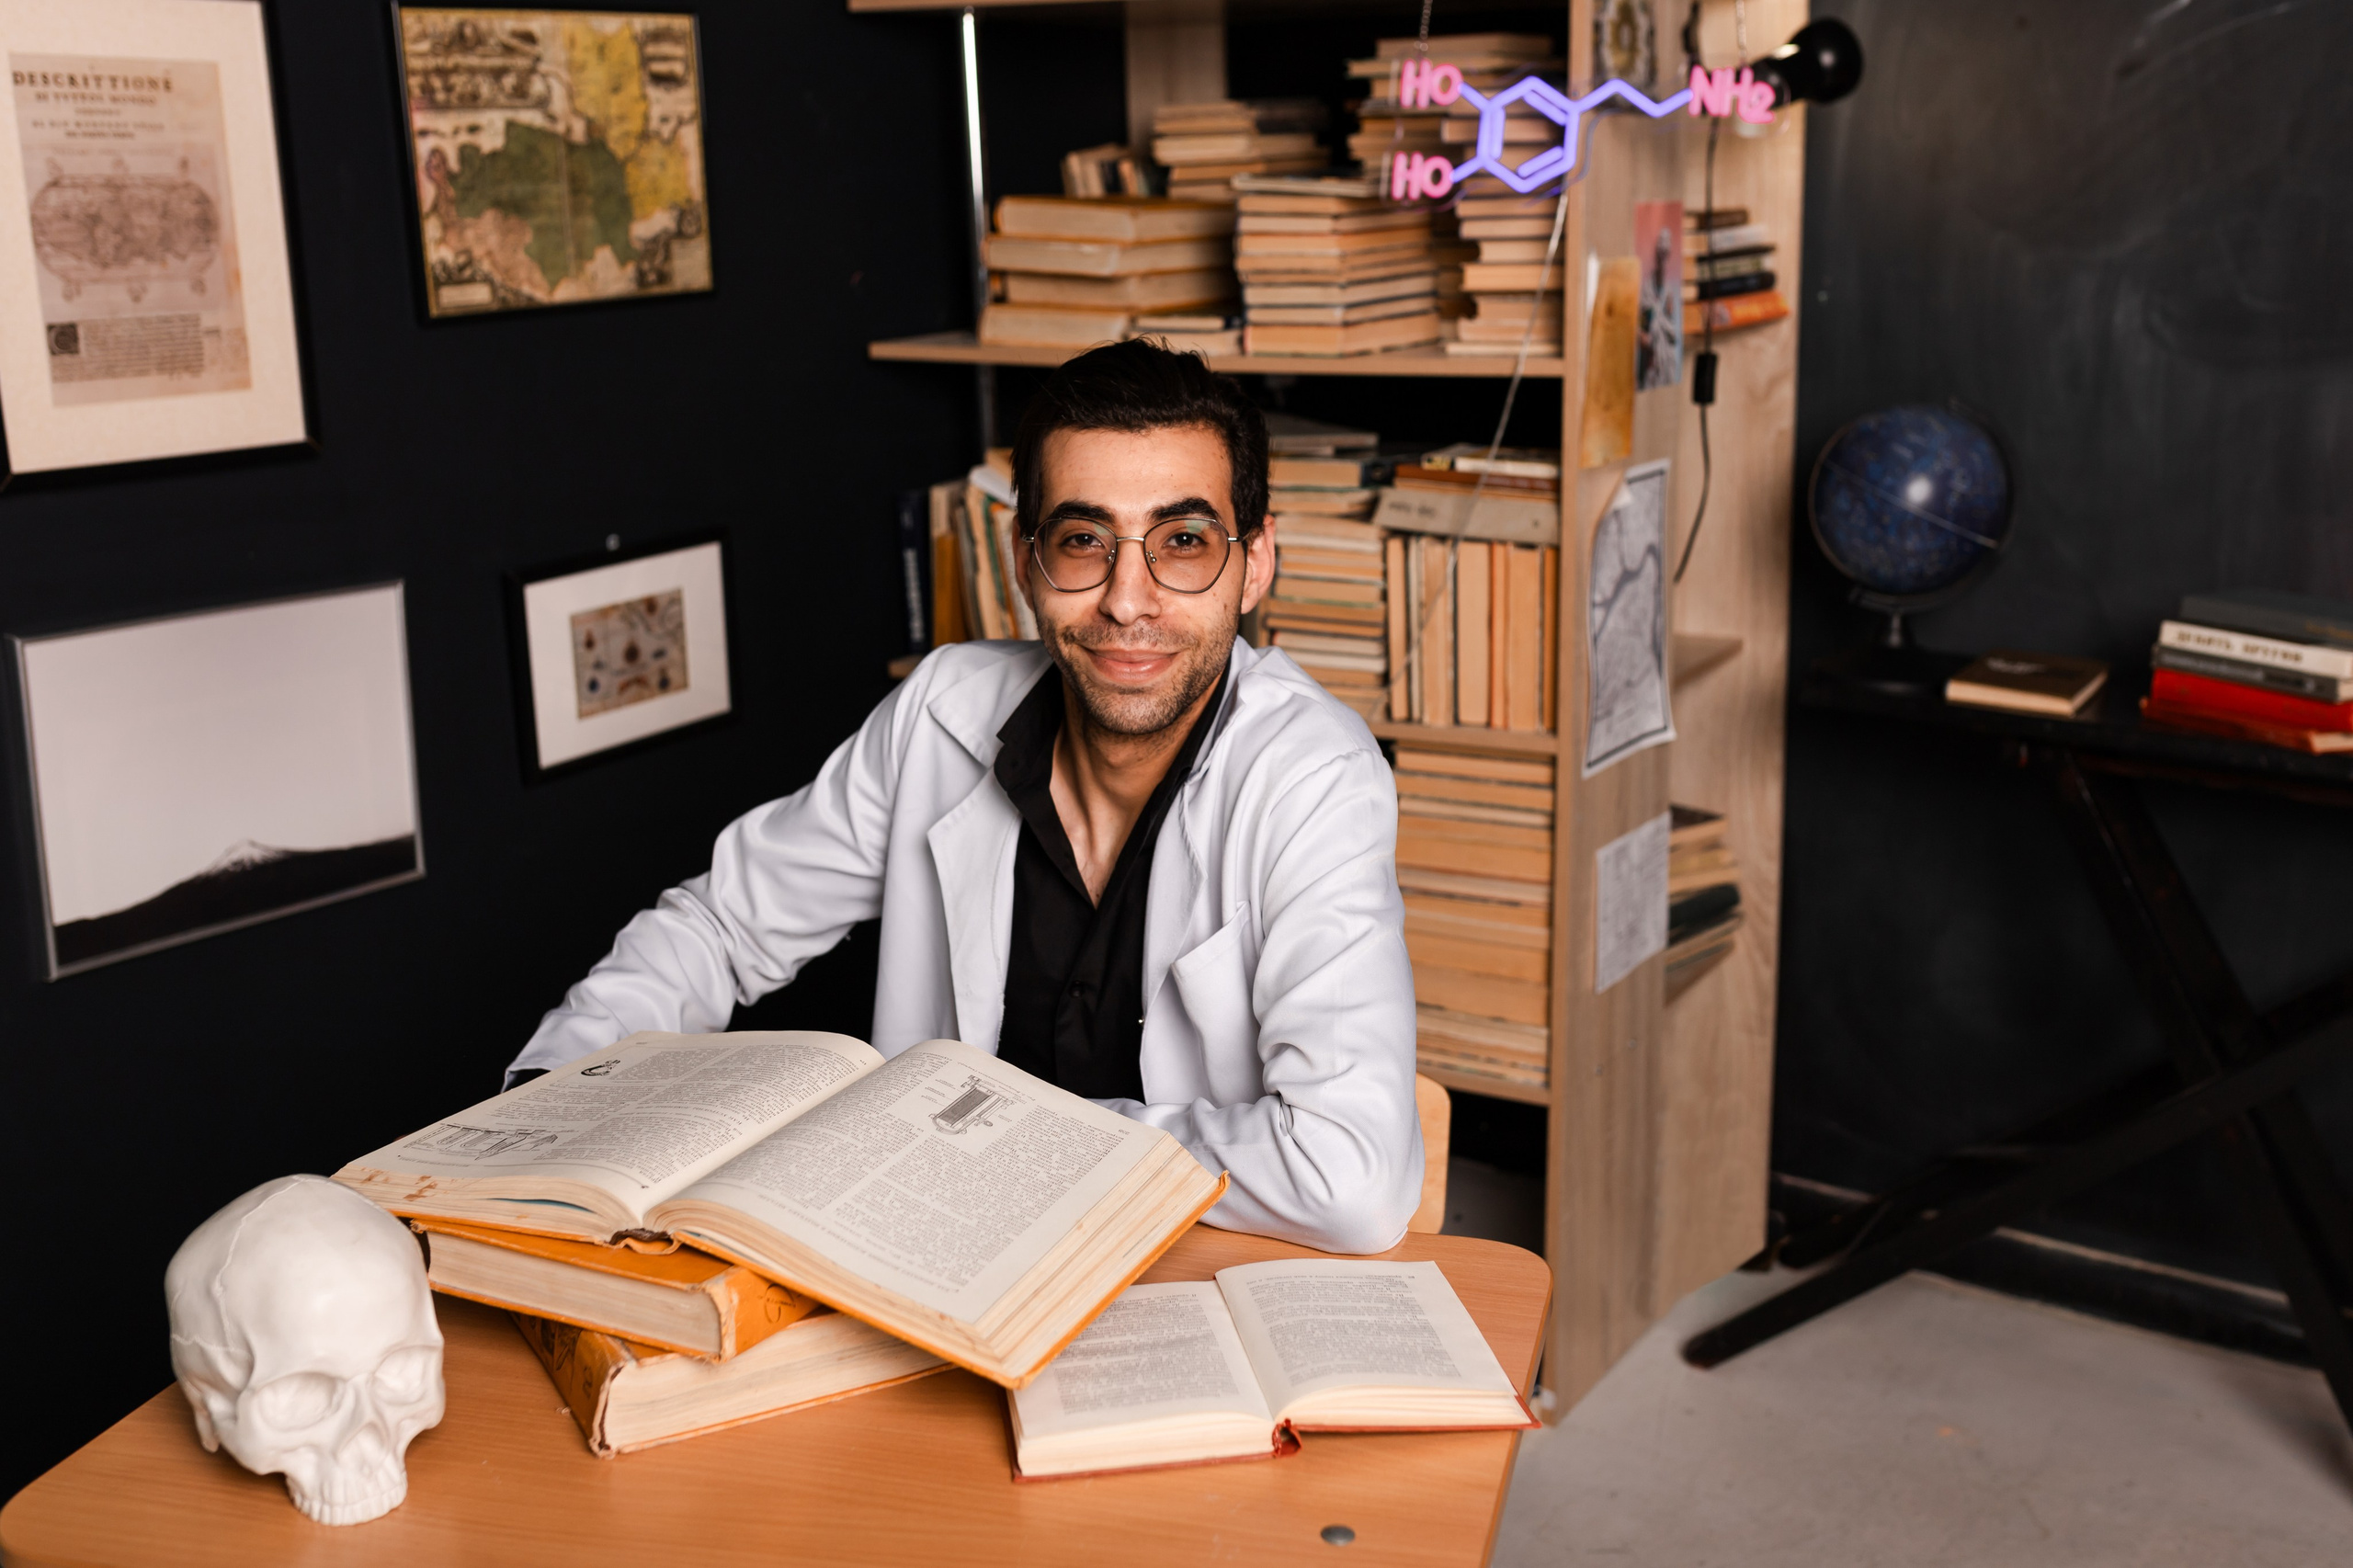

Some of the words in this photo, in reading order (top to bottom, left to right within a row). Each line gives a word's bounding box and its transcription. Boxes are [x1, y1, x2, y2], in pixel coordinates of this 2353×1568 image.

[13, 71, 173, 93] DESCRITTIONE
[1401, 59, 1463, 110] HO
[1392, 151, 1454, 201] HO
